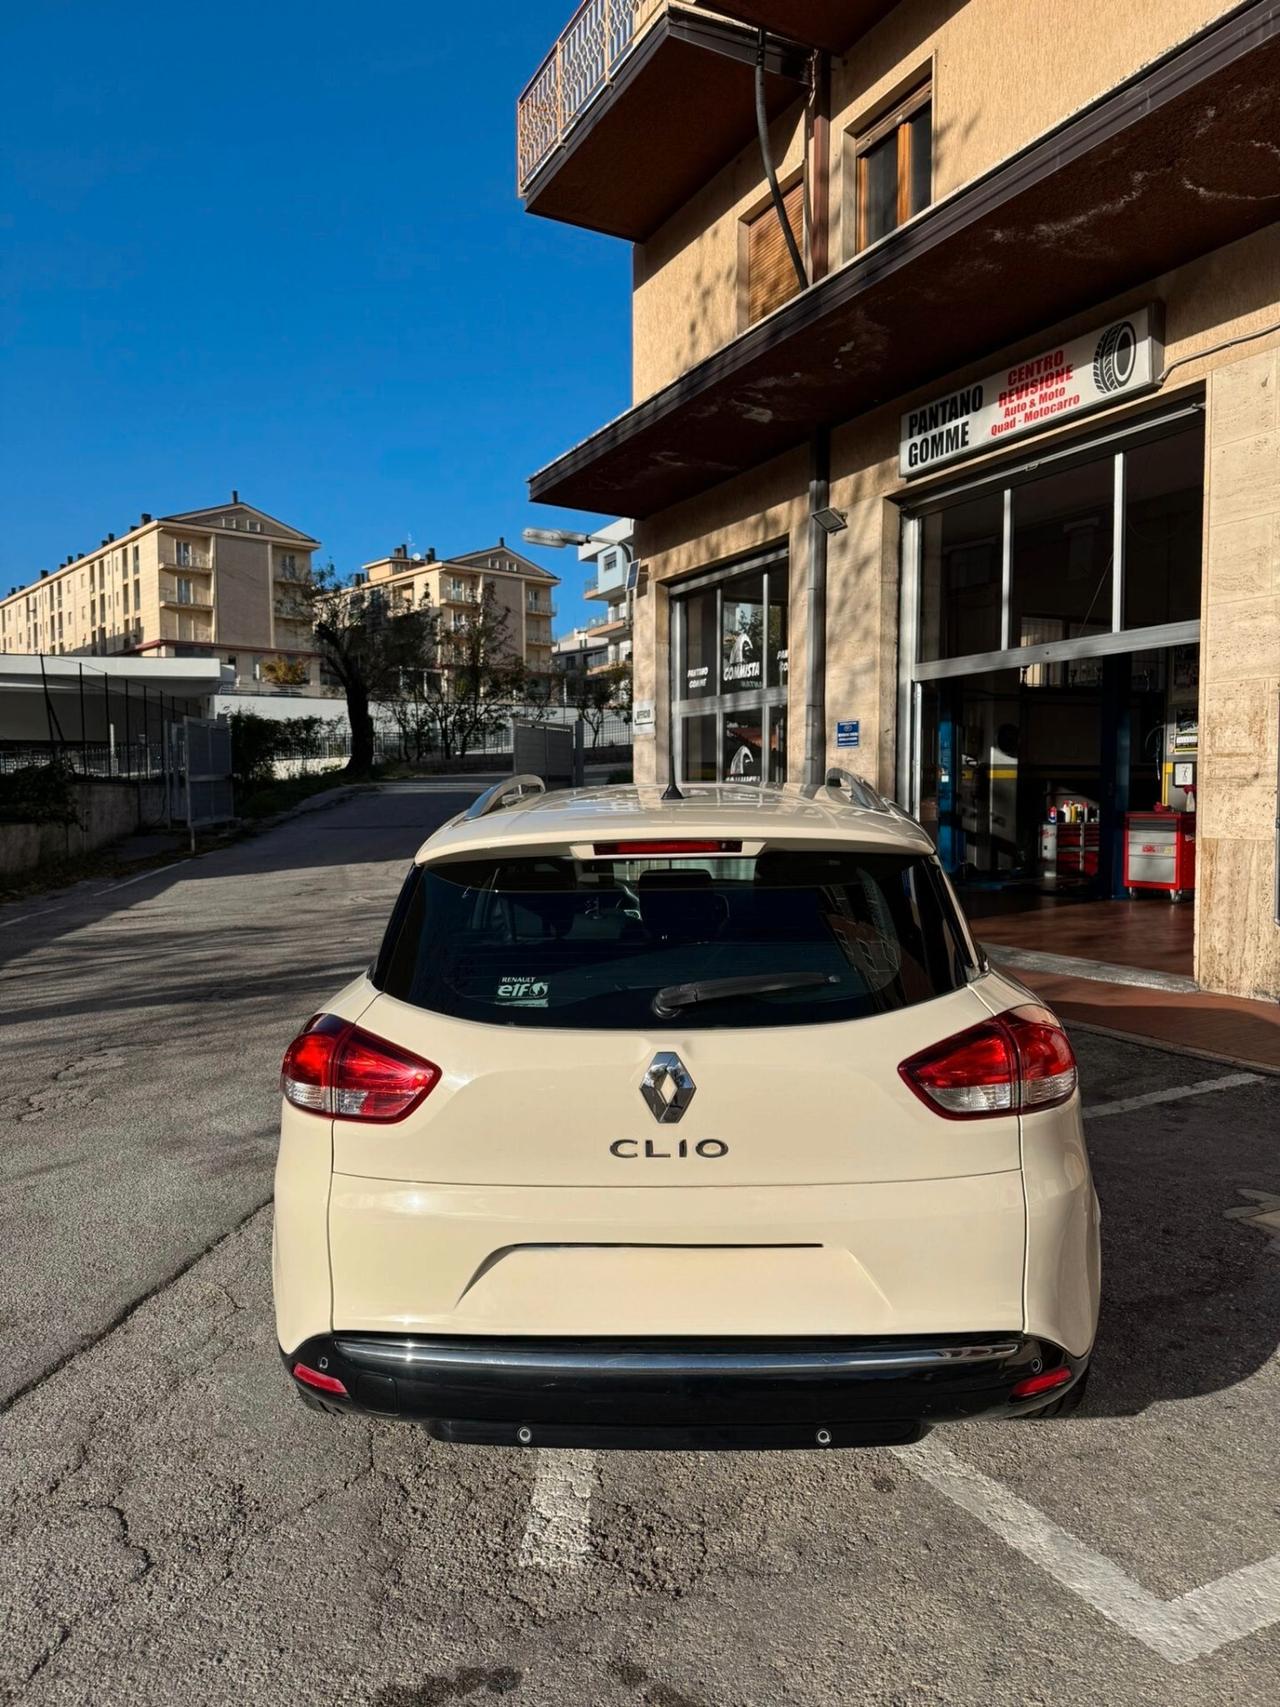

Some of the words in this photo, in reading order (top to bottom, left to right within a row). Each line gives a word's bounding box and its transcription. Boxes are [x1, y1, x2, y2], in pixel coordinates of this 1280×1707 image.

[998, 364, 1074, 408] REVISIONE
[1008, 350, 1064, 387] CENTRO
[908, 385, 984, 439] PANTANO
[991, 417, 1016, 436] Quad
[1024, 394, 1080, 423] Motocarro
[1004, 402, 1027, 418] Auto
[1029, 398, 1036, 408] &
[1039, 387, 1066, 405] Moto
[908, 421, 969, 467] GOMME
[723, 661, 760, 682] GOMMISTA
[609, 1138, 729, 1158] CLIO
